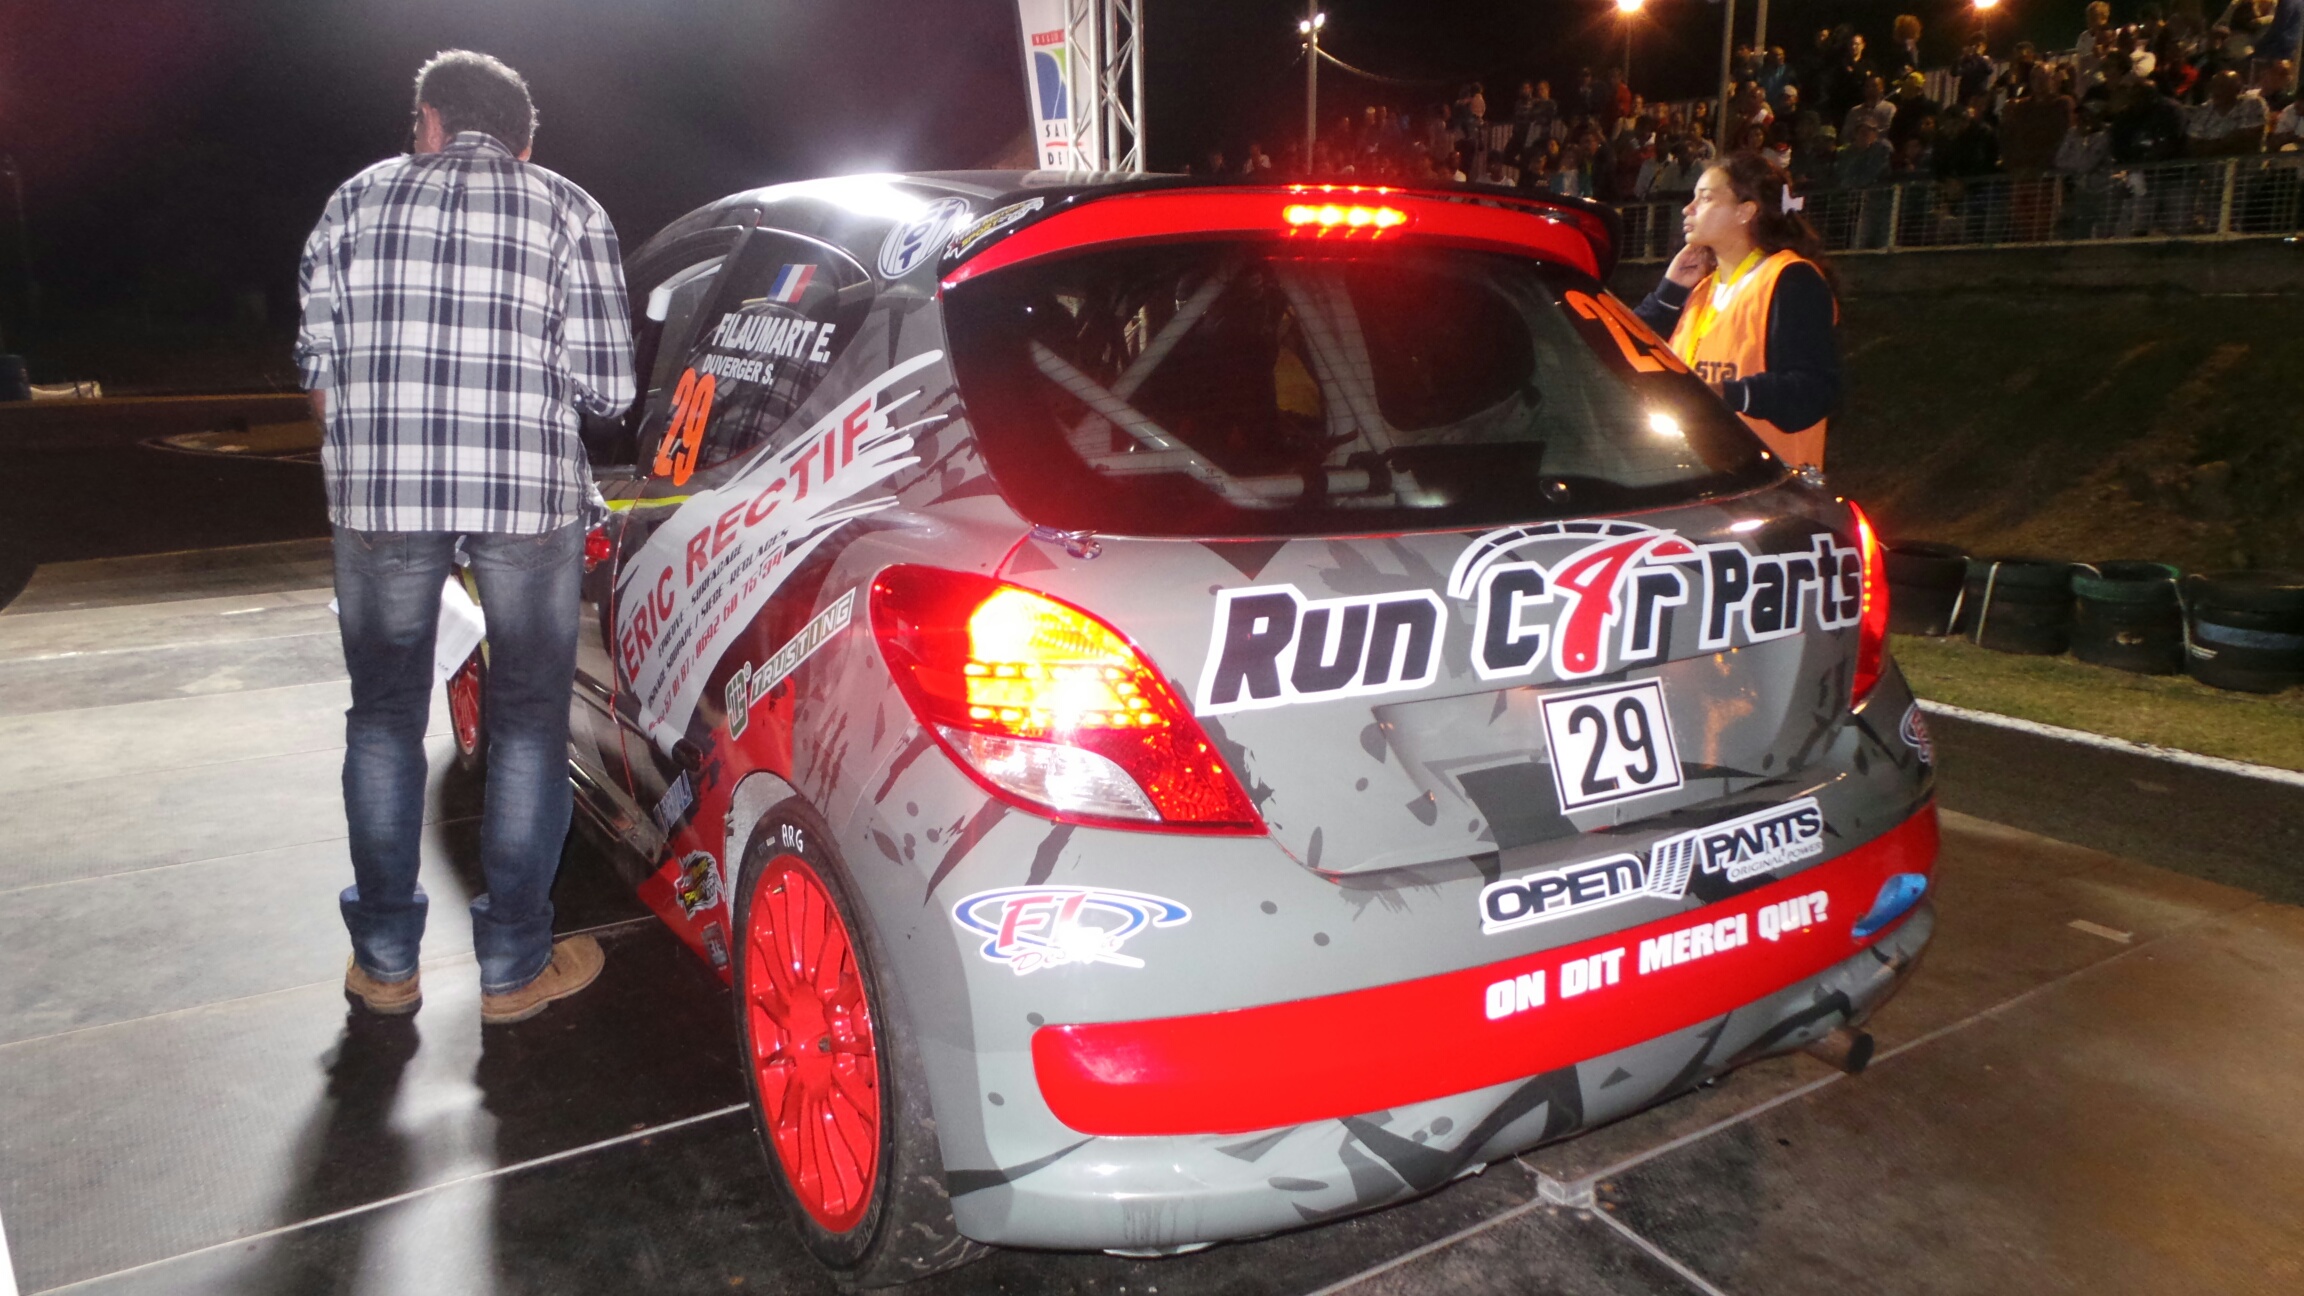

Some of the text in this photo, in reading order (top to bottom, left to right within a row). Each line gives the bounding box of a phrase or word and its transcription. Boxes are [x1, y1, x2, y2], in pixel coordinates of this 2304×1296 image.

[701, 353, 775, 385] DUVERGER S.
[711, 313, 837, 364] FILAUMART E.
[653, 367, 716, 487] 29
[621, 396, 873, 685] ERIC RECTIF
[1704, 536, 1862, 645] Parts
[752, 598, 851, 696] TRUSTING
[1567, 695, 1659, 796] 29
[781, 823, 804, 853] ARG
[1703, 807, 1822, 867] PARTS
[1730, 841, 1824, 878] ORIGINAL POWER
[1485, 890, 1829, 1020] ON DIT MERCI QUI?
